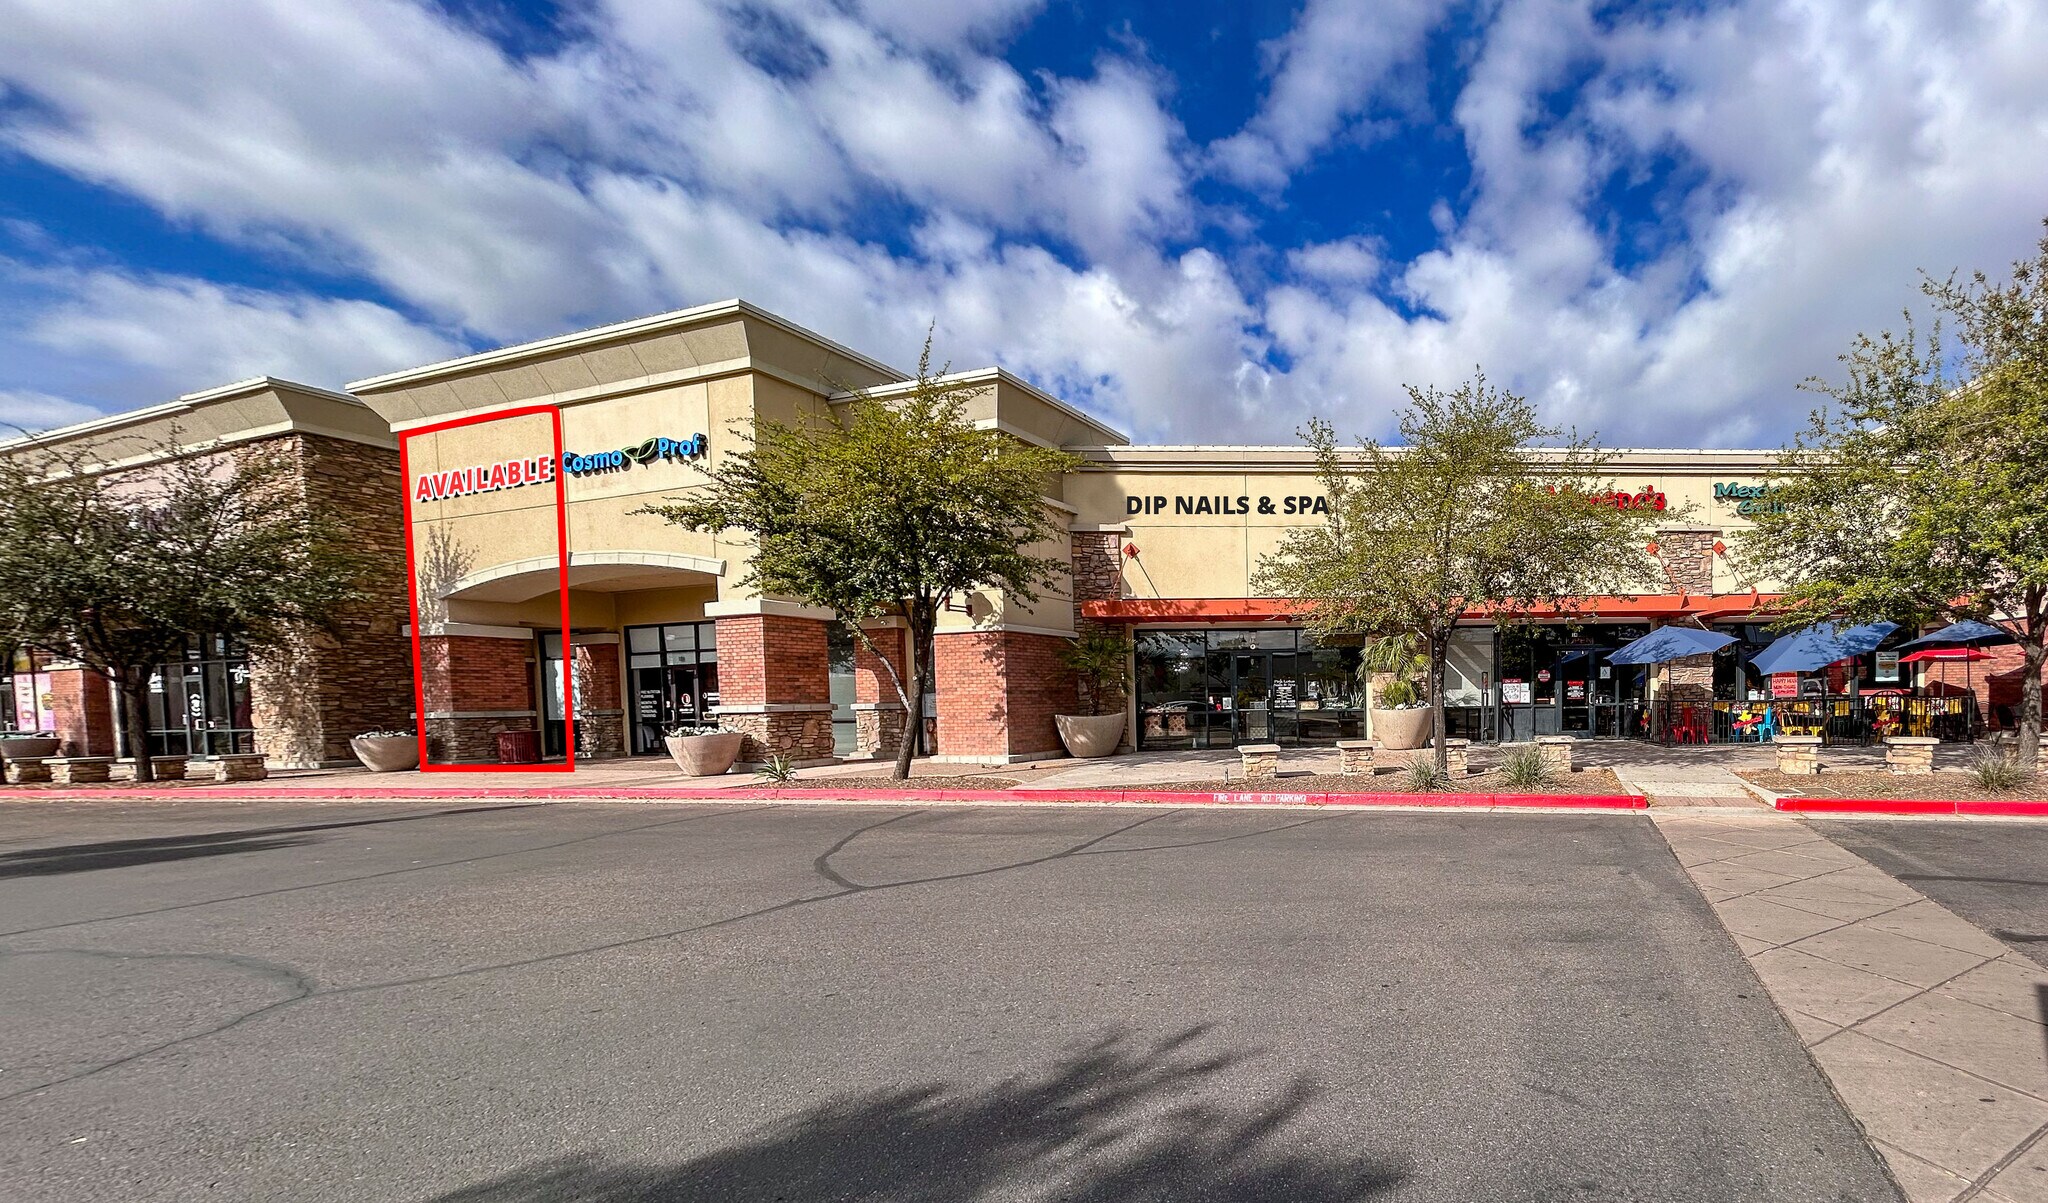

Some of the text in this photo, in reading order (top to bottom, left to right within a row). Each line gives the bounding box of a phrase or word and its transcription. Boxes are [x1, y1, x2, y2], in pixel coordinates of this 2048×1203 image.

[562, 433, 702, 474] Cosmo Prof
[1126, 496, 1329, 515] DIP NAILS & SPA
[1213, 794, 1229, 802] FIRE
[1234, 794, 1254, 802] LANE
[1276, 794, 1307, 803] PARKING
